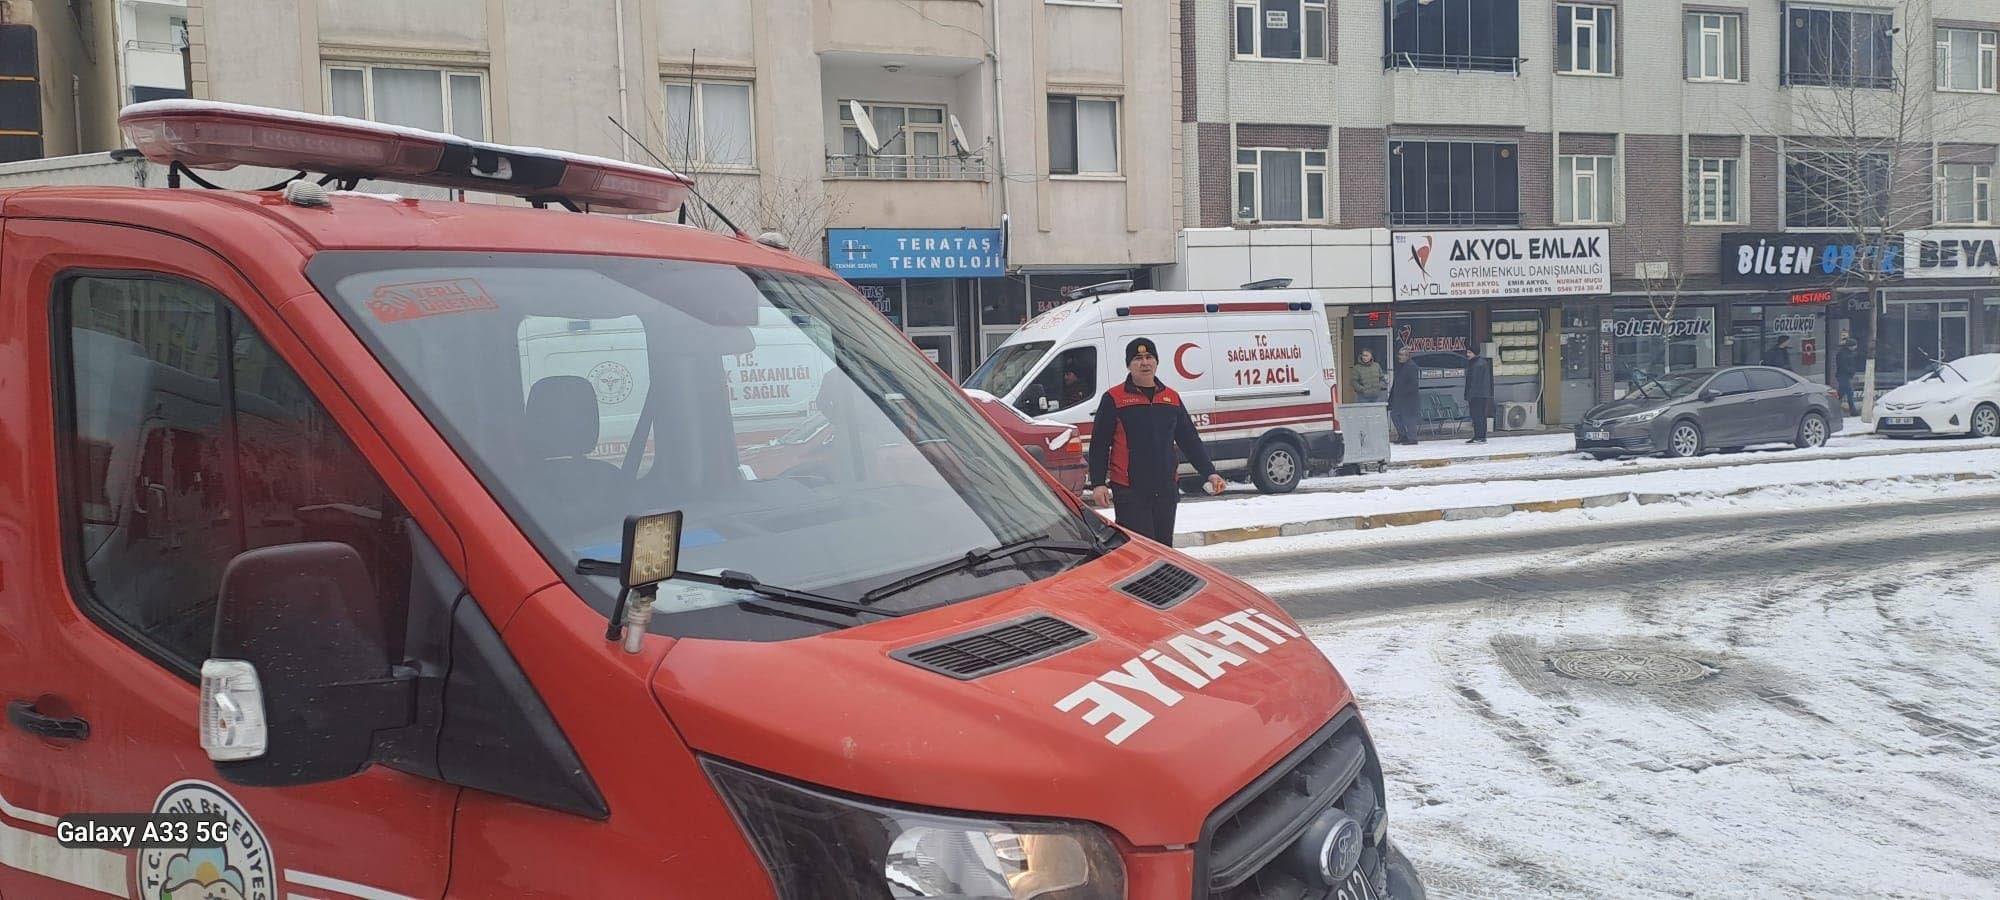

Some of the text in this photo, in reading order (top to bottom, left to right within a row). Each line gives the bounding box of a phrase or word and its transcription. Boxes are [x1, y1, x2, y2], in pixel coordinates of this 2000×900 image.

[897, 237, 991, 253] TERATAŞ
[1450, 237, 1601, 261] AKYOL EMLAK
[889, 253, 1000, 269] TEKNOLOJİ
[1738, 239, 1899, 275] BİLEN OPK
[1450, 263, 1603, 278] GAYRİMENKUL DANIŞMANLIĞI
[1792, 292, 1831, 303] MUSTANG
[1616, 318, 1661, 336] BİLEN
[1774, 314, 1815, 334] GÖZLÜKÇÜ
[1227, 344, 1302, 362] SAĞLIK BAKANLIĞI
[1409, 337, 1466, 351] AKYOL EMLAK
[740, 365, 810, 383] BAKANLIĞI
[1235, 364, 1300, 385] 112 ACİL
[743, 383, 790, 400] SAĞLIK
[148, 851, 162, 889] T.C.
